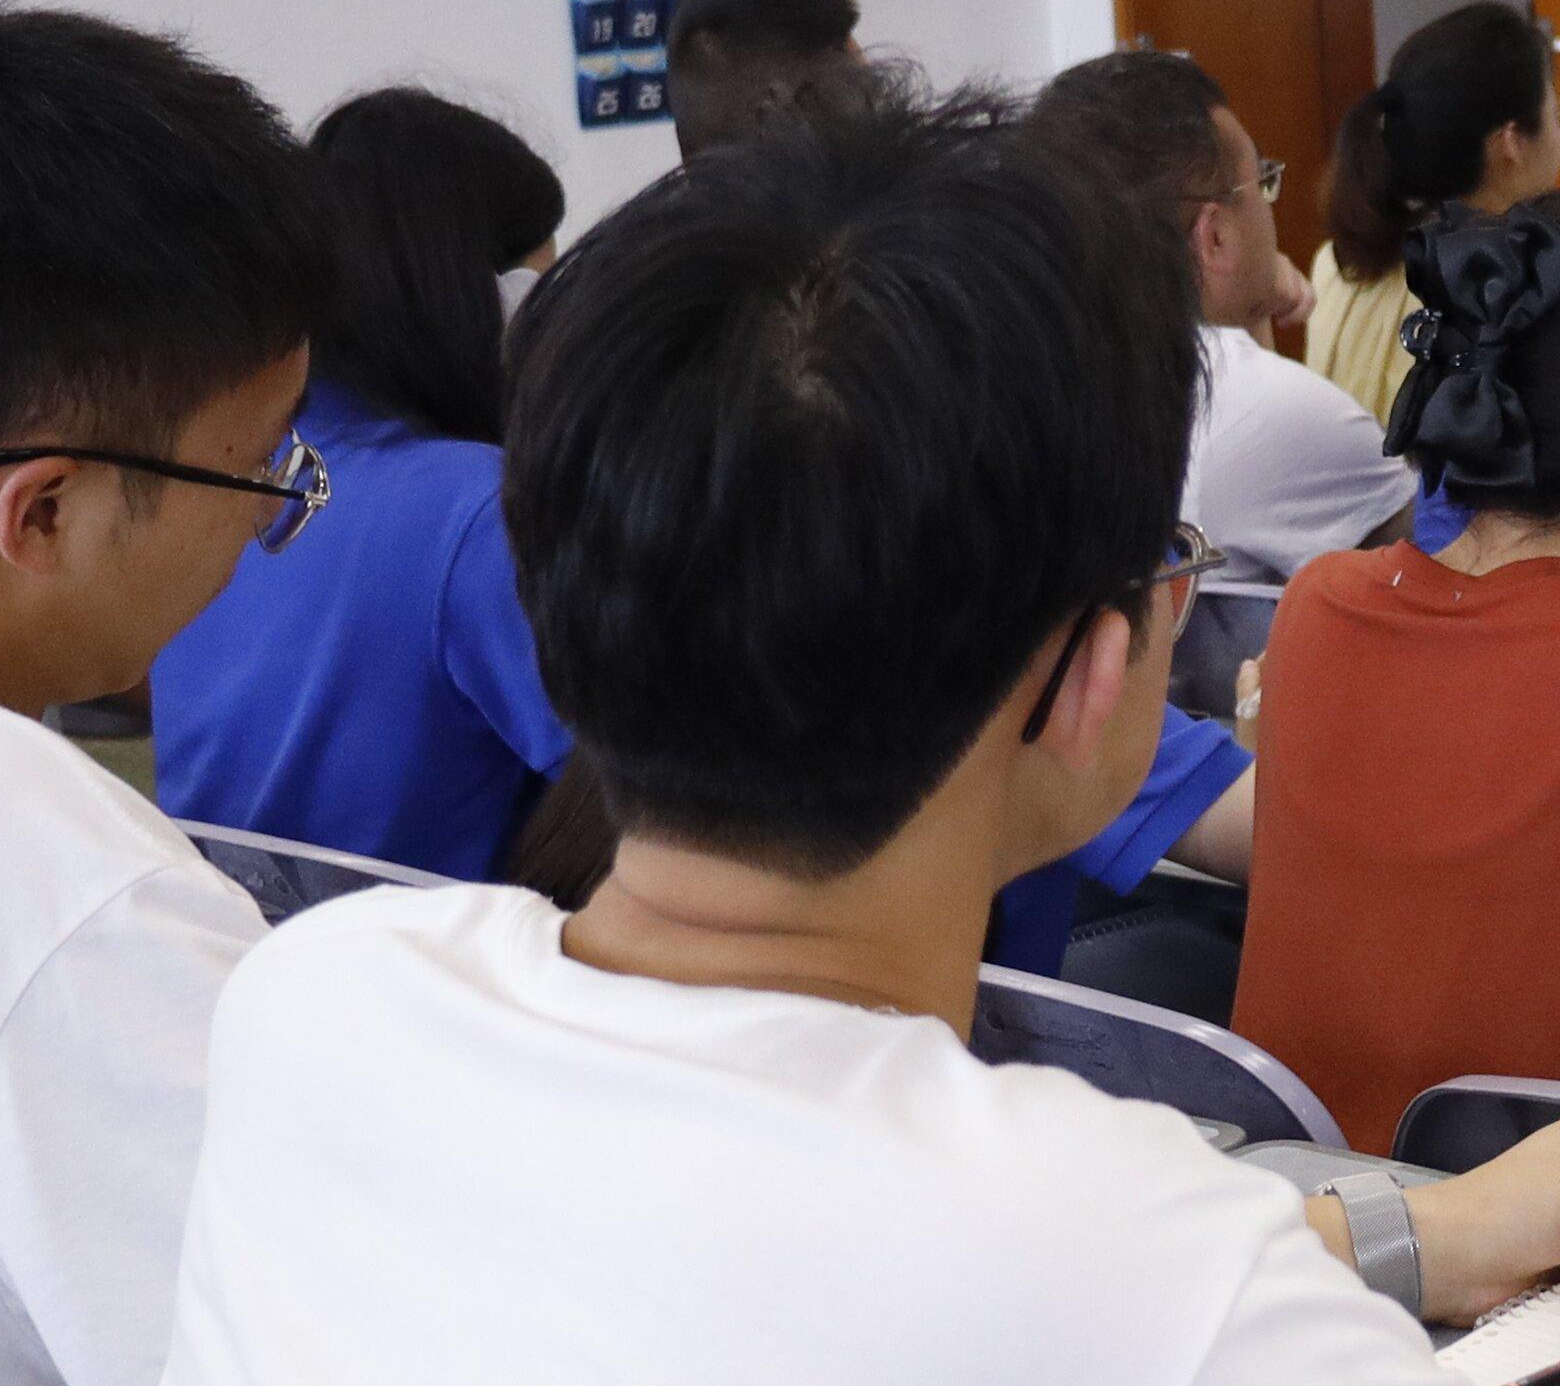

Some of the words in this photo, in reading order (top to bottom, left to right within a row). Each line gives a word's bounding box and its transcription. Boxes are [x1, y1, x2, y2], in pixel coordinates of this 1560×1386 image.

[593, 17, 613, 41] 19
[631, 11, 656, 37] 20
[596, 91, 618, 115] 25
[638, 84, 661, 109] 26
